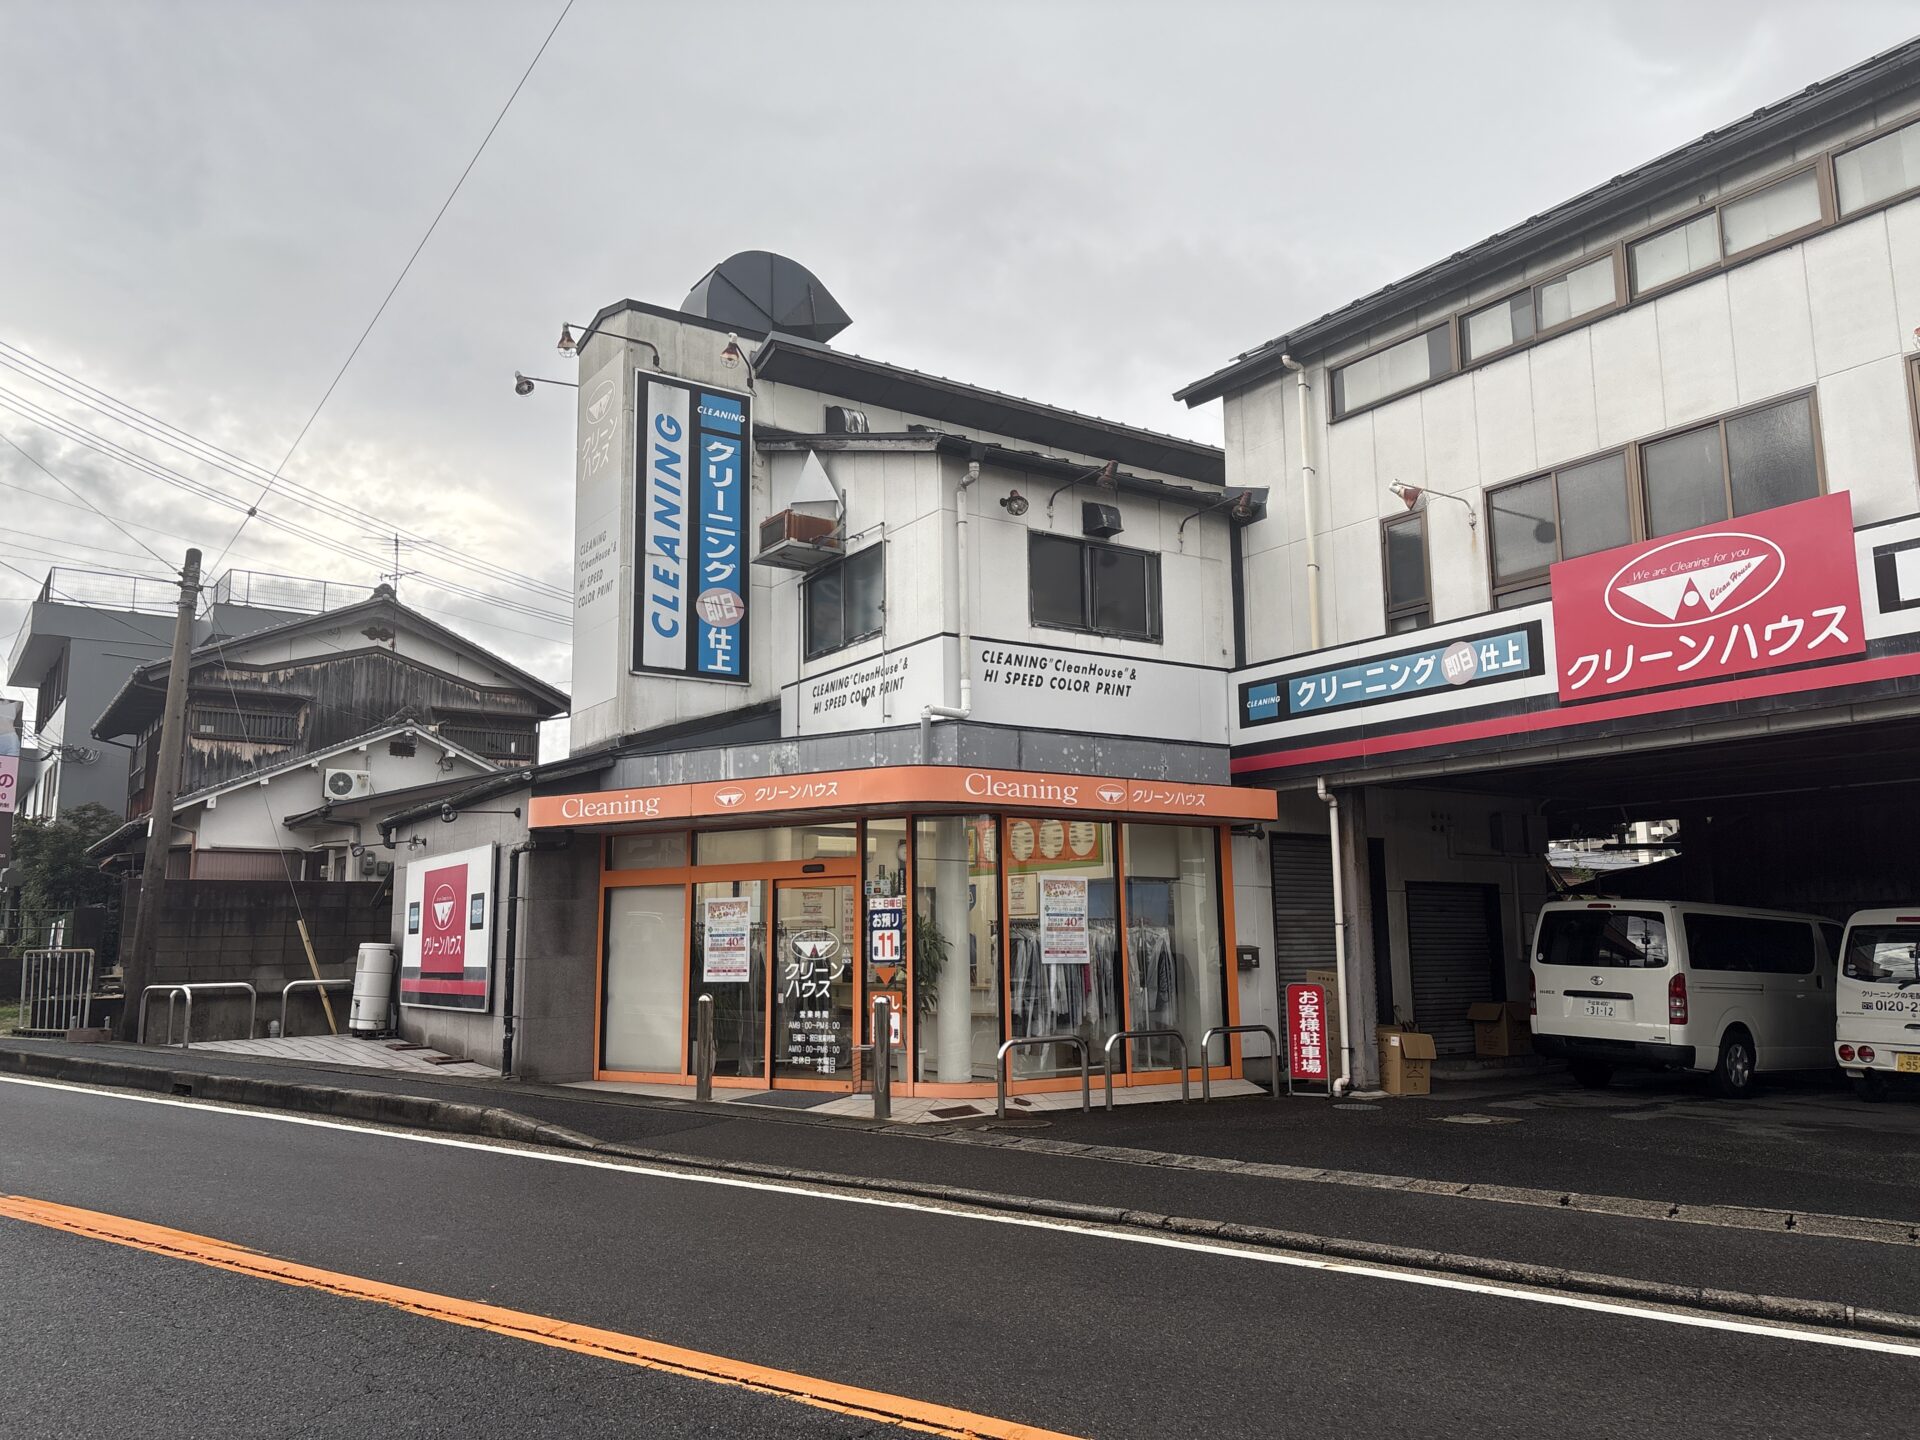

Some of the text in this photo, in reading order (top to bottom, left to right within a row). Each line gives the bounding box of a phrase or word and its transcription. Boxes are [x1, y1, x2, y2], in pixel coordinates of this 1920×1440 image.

[697, 404, 746, 423] CLEANING
[652, 412, 683, 639] CLEANING
[580, 530, 607, 556] CLEANING
[1632, 547, 1750, 581] We are Cleaning for you
[1567, 604, 1849, 690] クリーンハウス
[981, 650, 1048, 669] CLEANING
[812, 675, 850, 698] CLEANING
[983, 669, 1132, 697] HI SPEED COLOR PRINT
[813, 676, 905, 715] HI SPEED COLOR PRINT
[1246, 695, 1281, 709] CLEANING
[753, 781, 839, 802] クリーンハウス
[964, 773, 1079, 806] Cleaning
[1132, 790, 1206, 807] クリーンハウス
[561, 794, 661, 820] Cleaning
[872, 913, 900, 928] お預り
[424, 935, 463, 955] クリーンハウス
[878, 932, 894, 958] 11
[784, 961, 846, 980] クリーン
[785, 979, 831, 998] ハウス
[1875, 999, 1920, 1013] 0120-2
[1298, 990, 1322, 1074] お客様駐車場
